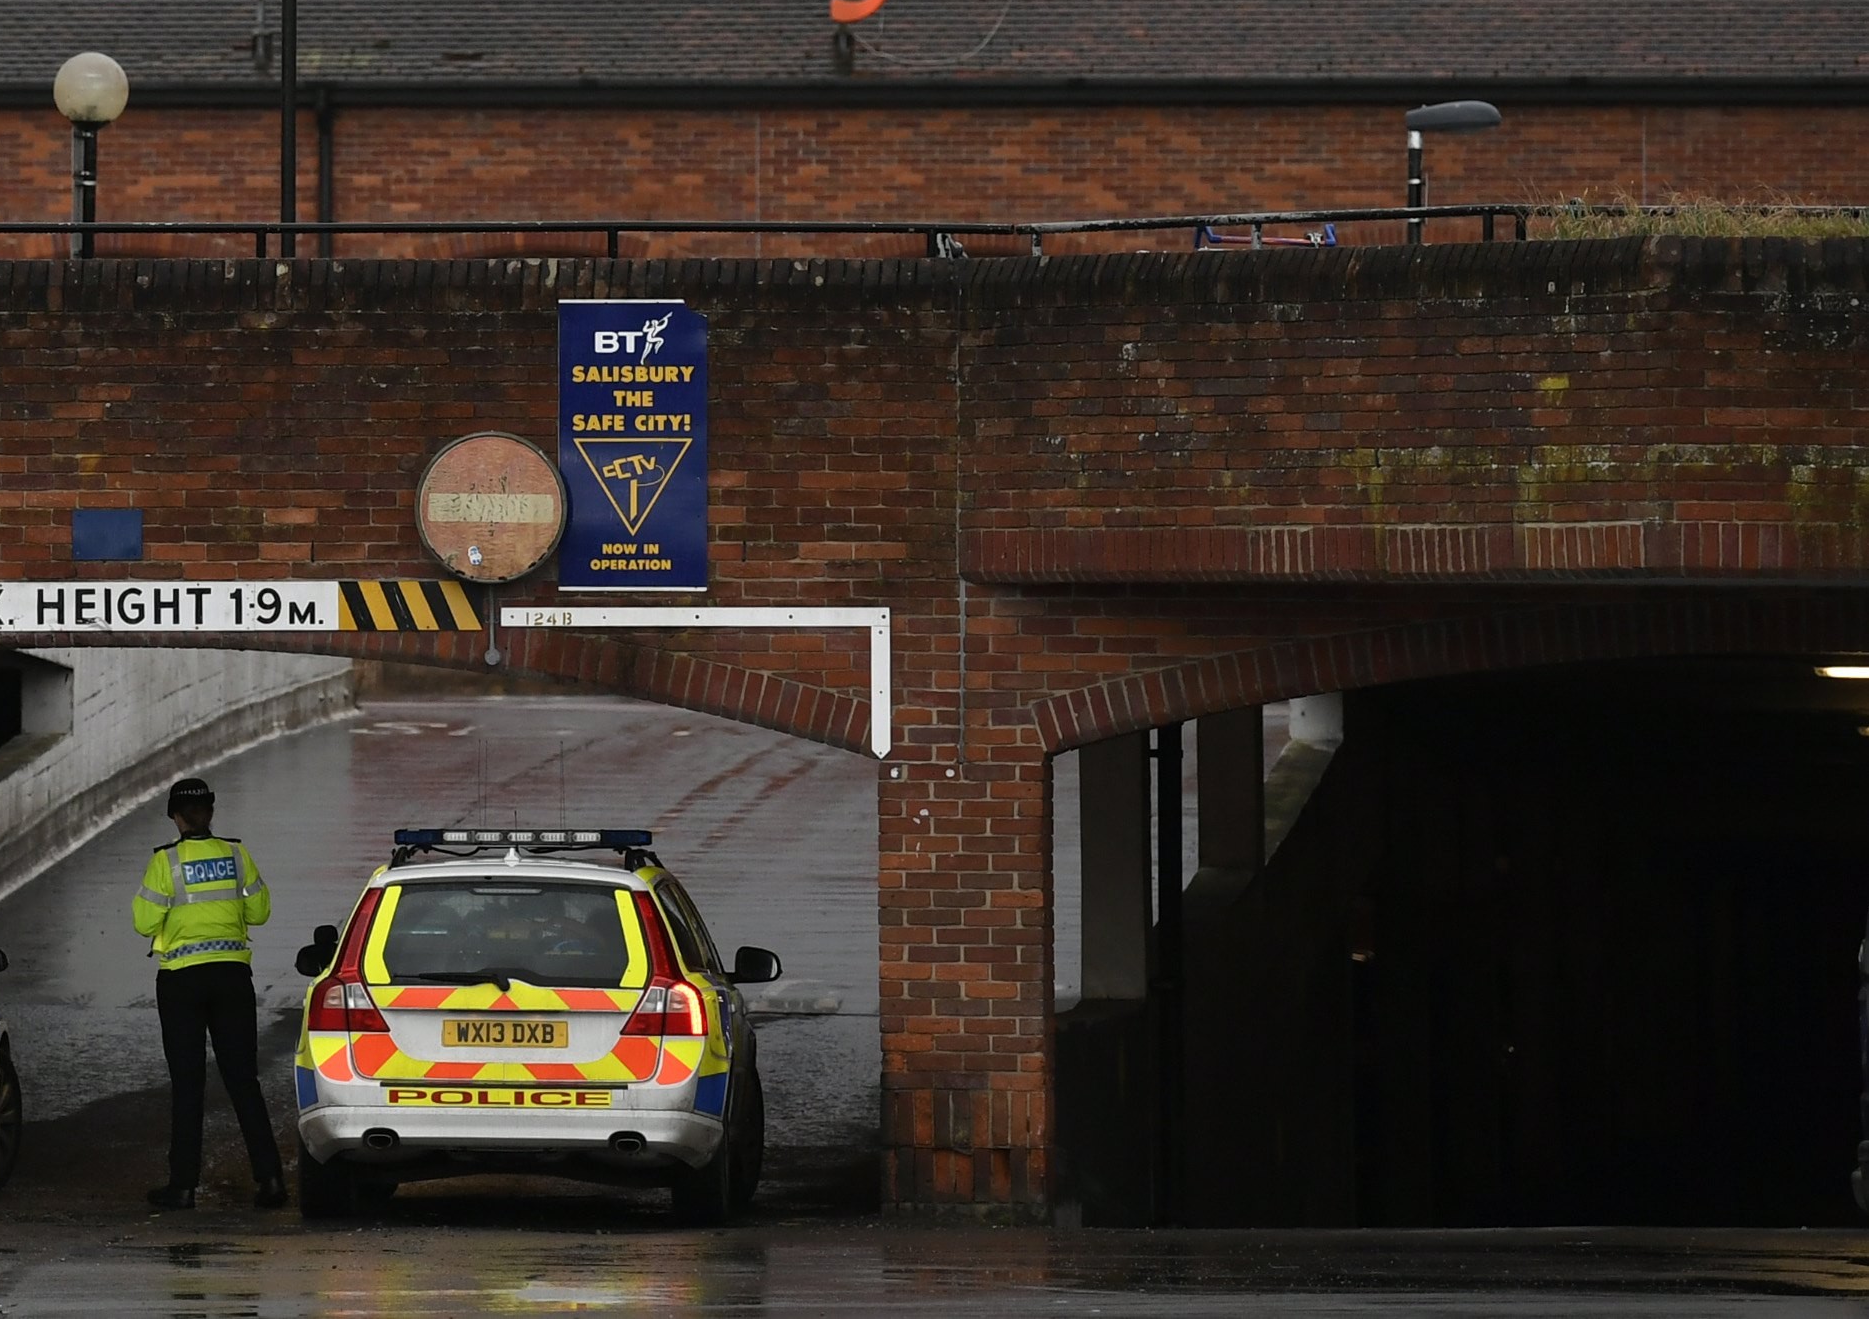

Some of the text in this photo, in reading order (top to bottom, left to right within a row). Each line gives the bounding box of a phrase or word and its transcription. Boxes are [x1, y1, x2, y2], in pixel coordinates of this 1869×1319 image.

[594, 331, 643, 353] BT
[572, 365, 694, 383] SALISBURY
[613, 390, 653, 407] THE
[572, 414, 691, 431] SAFE CITY!
[602, 454, 656, 479] CCTV
[602, 543, 659, 555] NOW IN
[590, 558, 672, 571] OPERATION
[36, 588, 211, 625] HEIGHT
[184, 860, 235, 881] POLICE
[456, 1021, 555, 1045] WX13 DXB
[388, 1089, 610, 1107] POLICE
